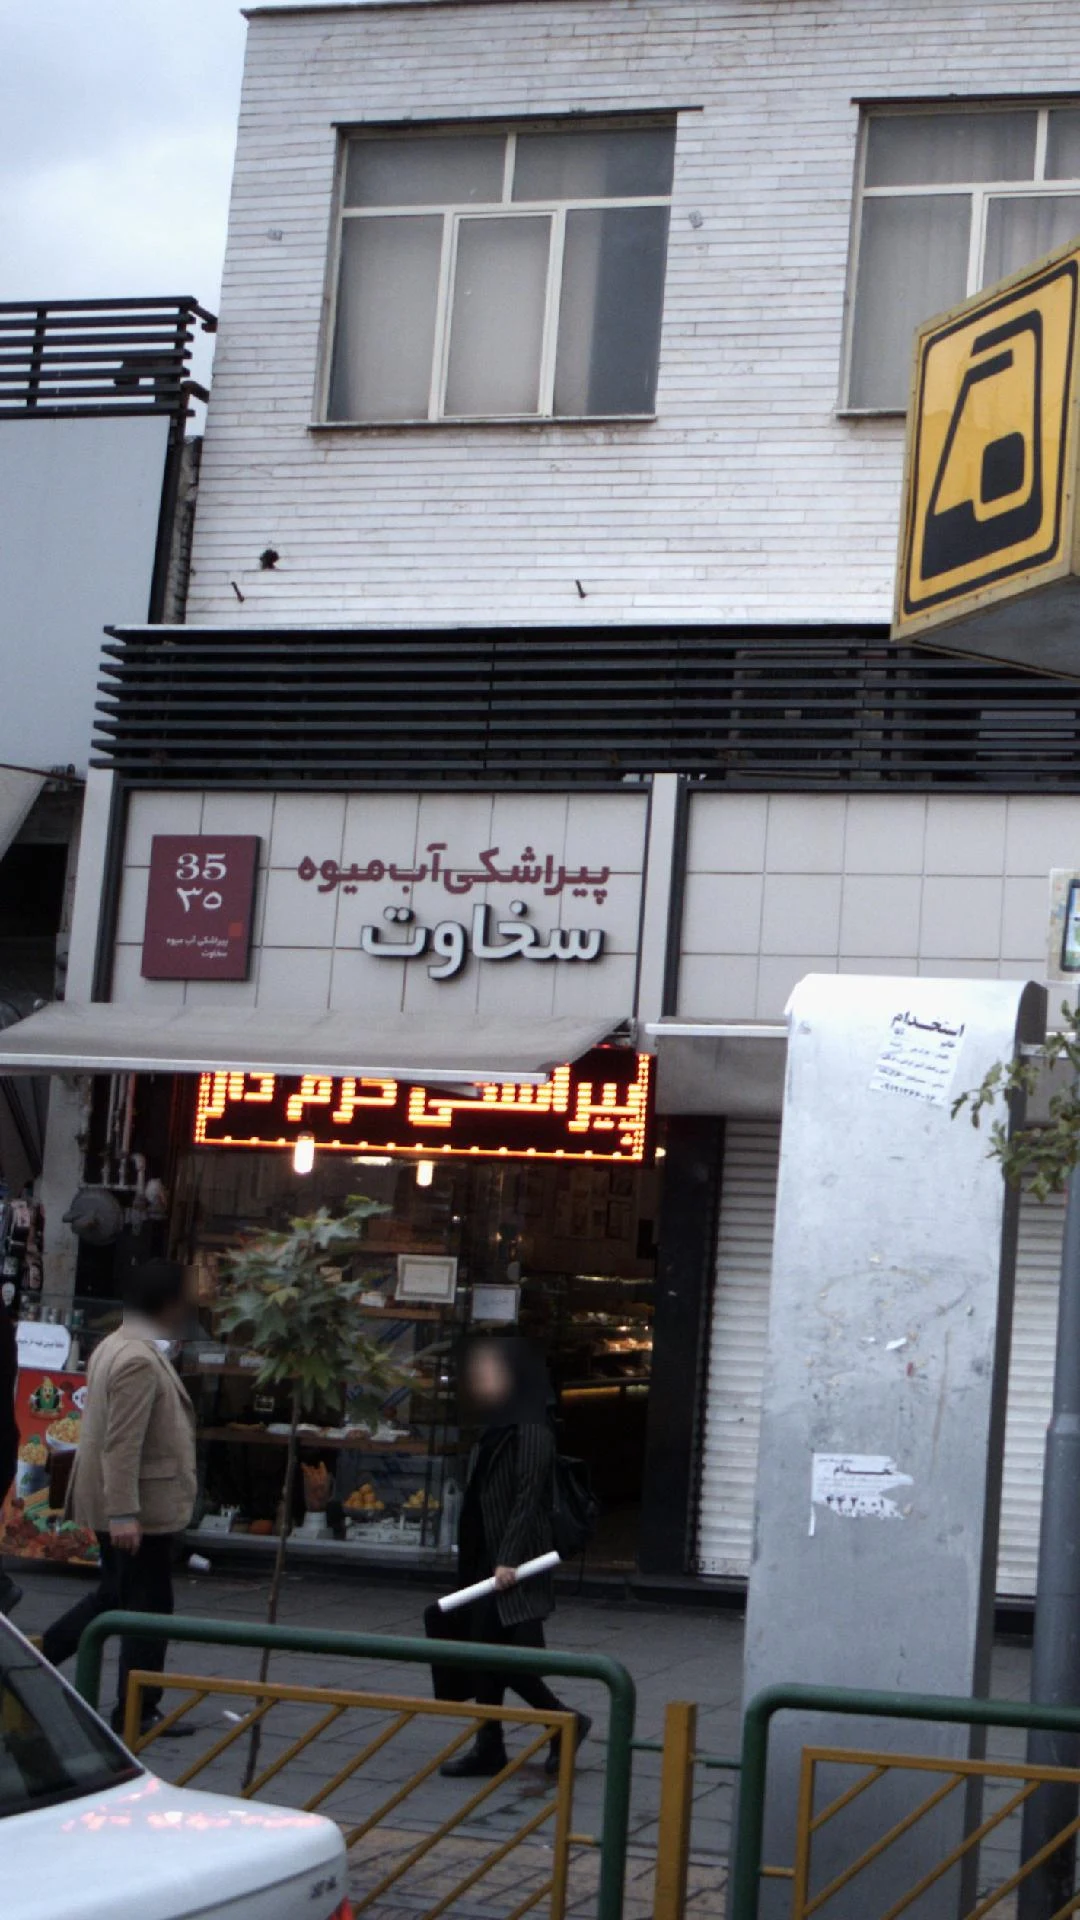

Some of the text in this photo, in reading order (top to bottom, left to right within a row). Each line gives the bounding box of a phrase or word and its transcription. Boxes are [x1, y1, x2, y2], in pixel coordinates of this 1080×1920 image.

[176, 852, 227, 880] 35
[298, 842, 611, 905] پیراشکی آب میوه
[176, 886, 223, 913] ۳۵
[361, 900, 606, 980] سخاوت
